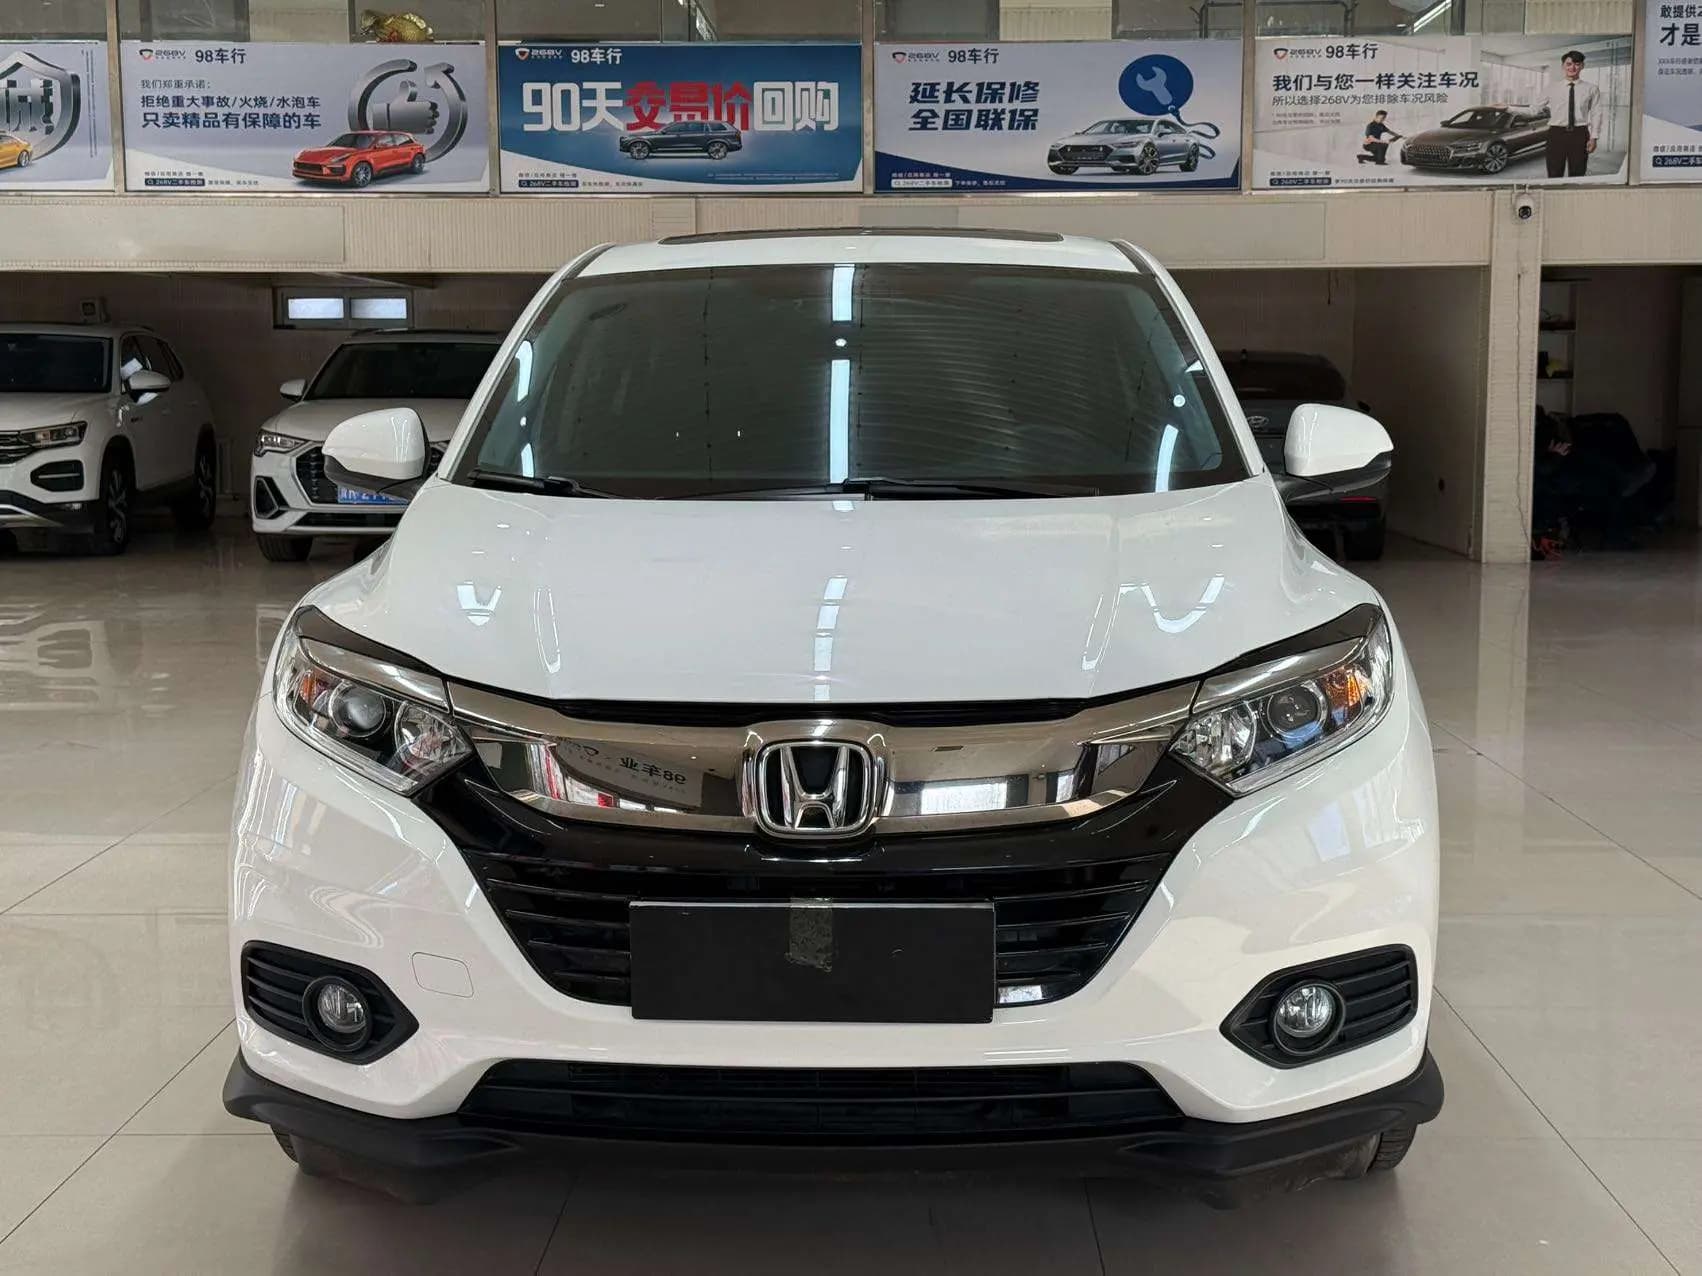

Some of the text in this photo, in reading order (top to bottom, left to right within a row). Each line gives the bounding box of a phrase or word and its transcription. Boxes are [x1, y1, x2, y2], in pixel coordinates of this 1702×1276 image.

[1659, 22, 1702, 47] 才是
[195, 47, 248, 65] 98车行
[570, 47, 623, 66] 98车行
[948, 47, 1000, 65] 98车行
[1325, 43, 1379, 61] 98车行
[1271, 71, 1480, 92] 我们与您一样关注车况
[140, 94, 322, 109] 拒绝重大事故/火烧/水泡车
[908, 80, 1041, 105] 延长保修
[1271, 92, 1449, 107] 所以选择268V为您排除车况风险
[522, 80, 840, 132] 90天交易价回购
[141, 111, 323, 130] 只卖精品有保障的车
[907, 107, 1040, 131] 全国联保
